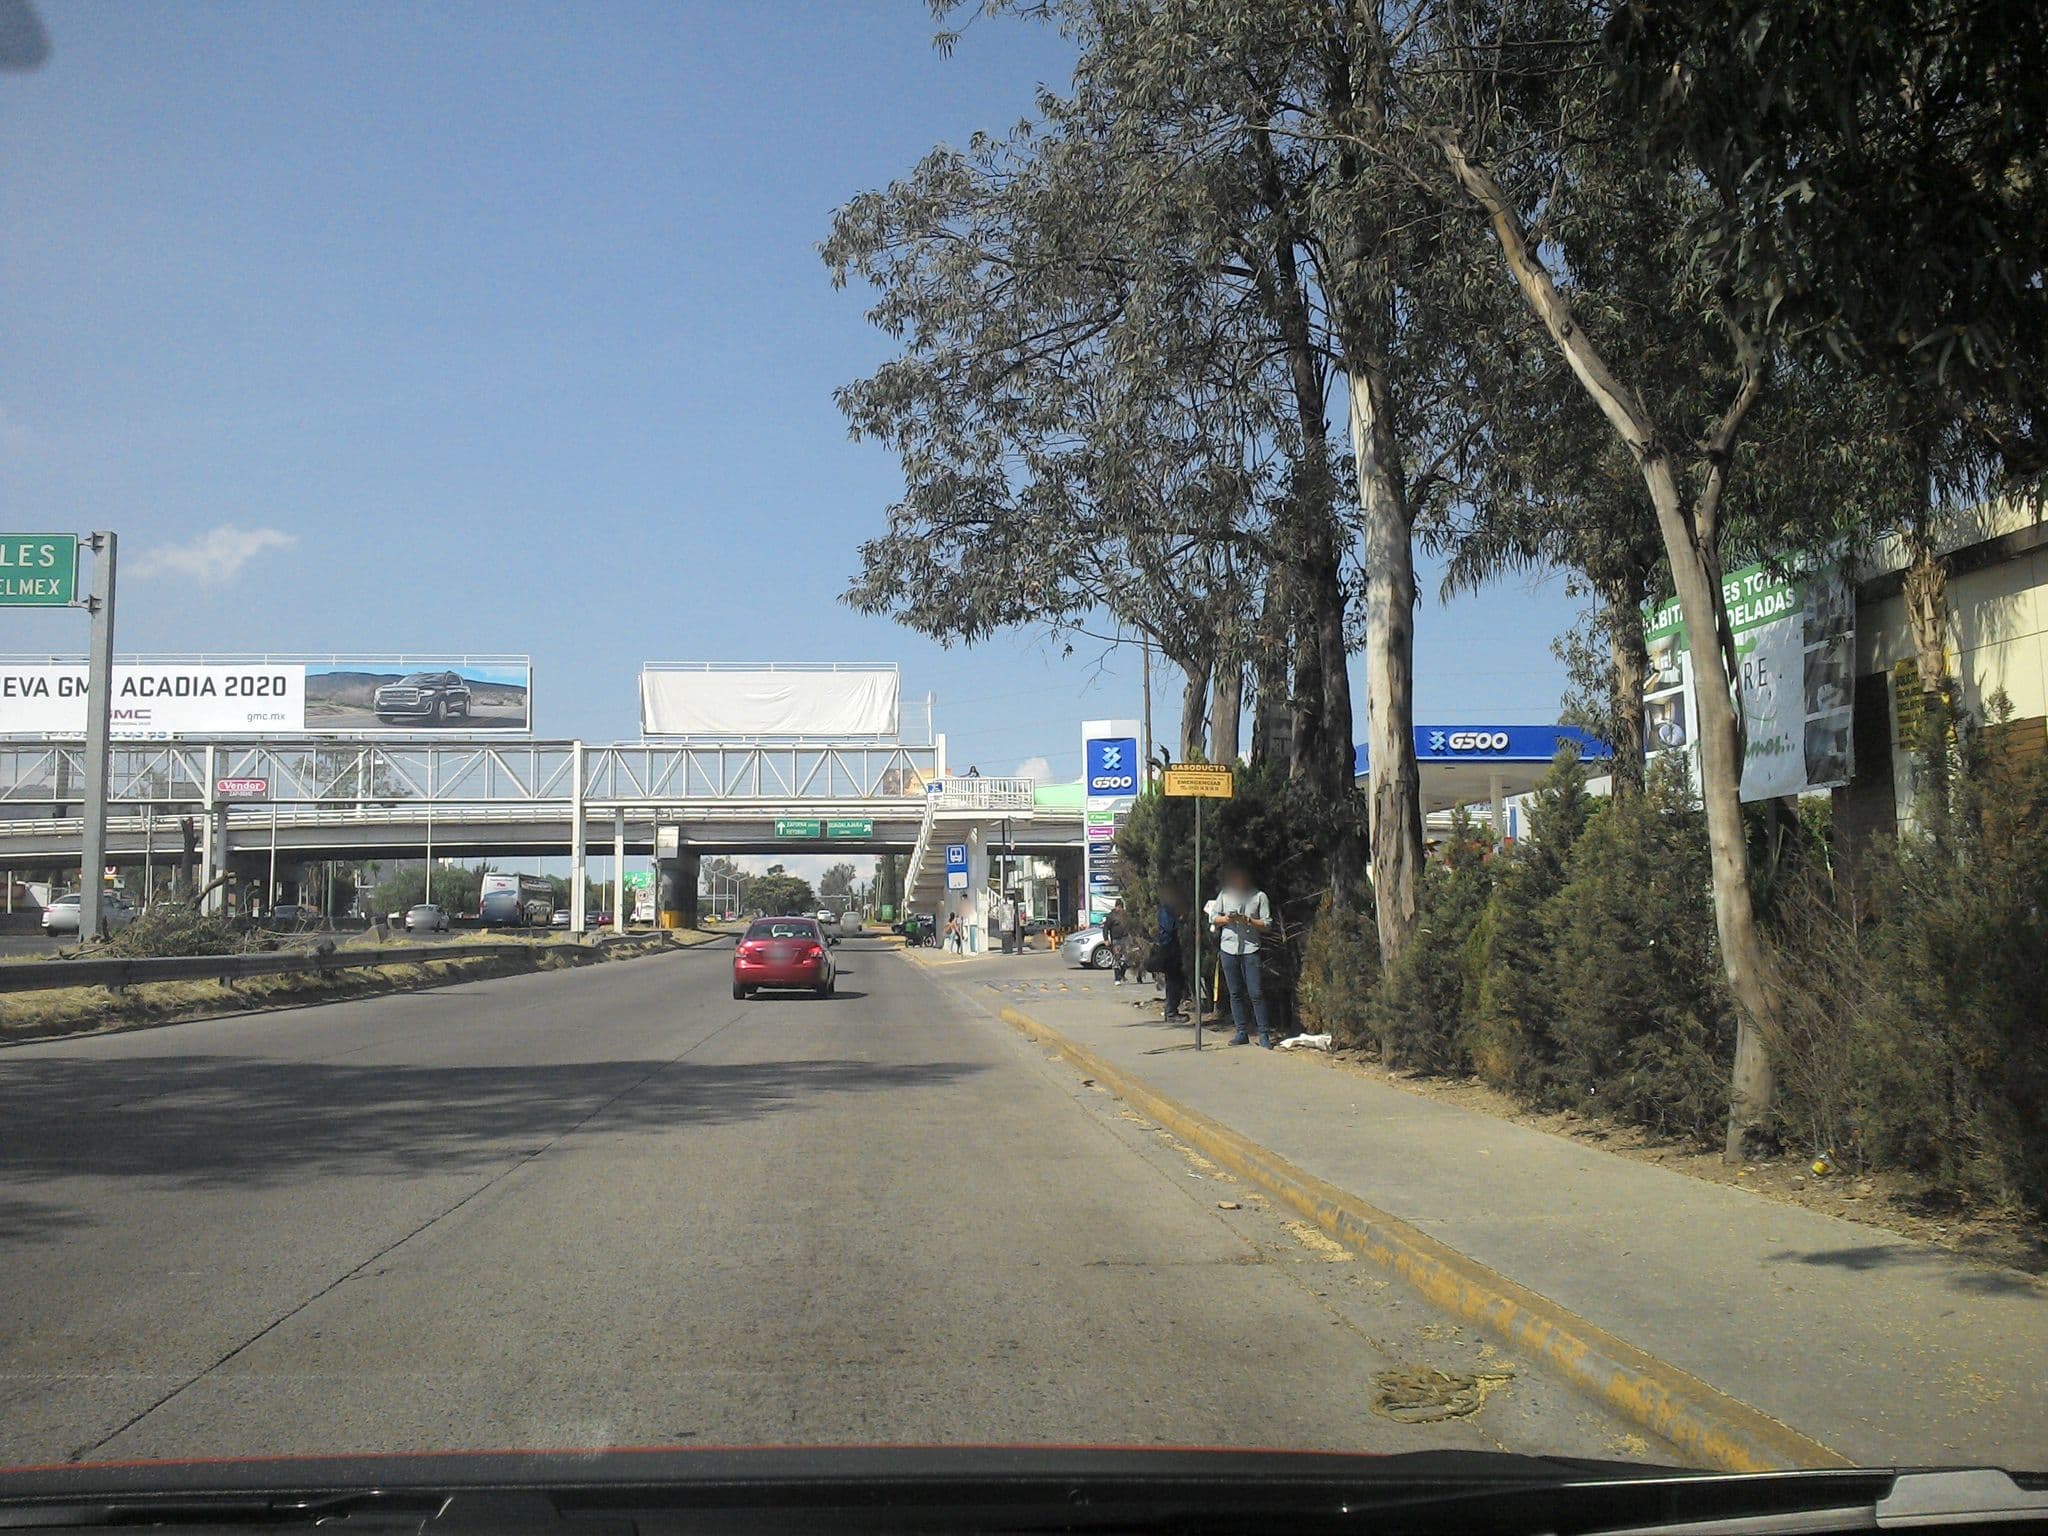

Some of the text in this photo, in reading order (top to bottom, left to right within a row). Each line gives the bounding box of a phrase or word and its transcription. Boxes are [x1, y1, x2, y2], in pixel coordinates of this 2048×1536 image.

[1716, 587, 1795, 632] DELADAS
[58, 676, 89, 697] GM
[120, 676, 217, 697] ACADIA
[225, 676, 287, 697] 2020
[109, 709, 152, 719] MC
[247, 712, 286, 723] gmc.mx
[1448, 732, 1509, 750] G500
[1171, 764, 1227, 772] GASODUCTO
[223, 781, 261, 791] Vendor
[1092, 776, 1133, 789] G500
